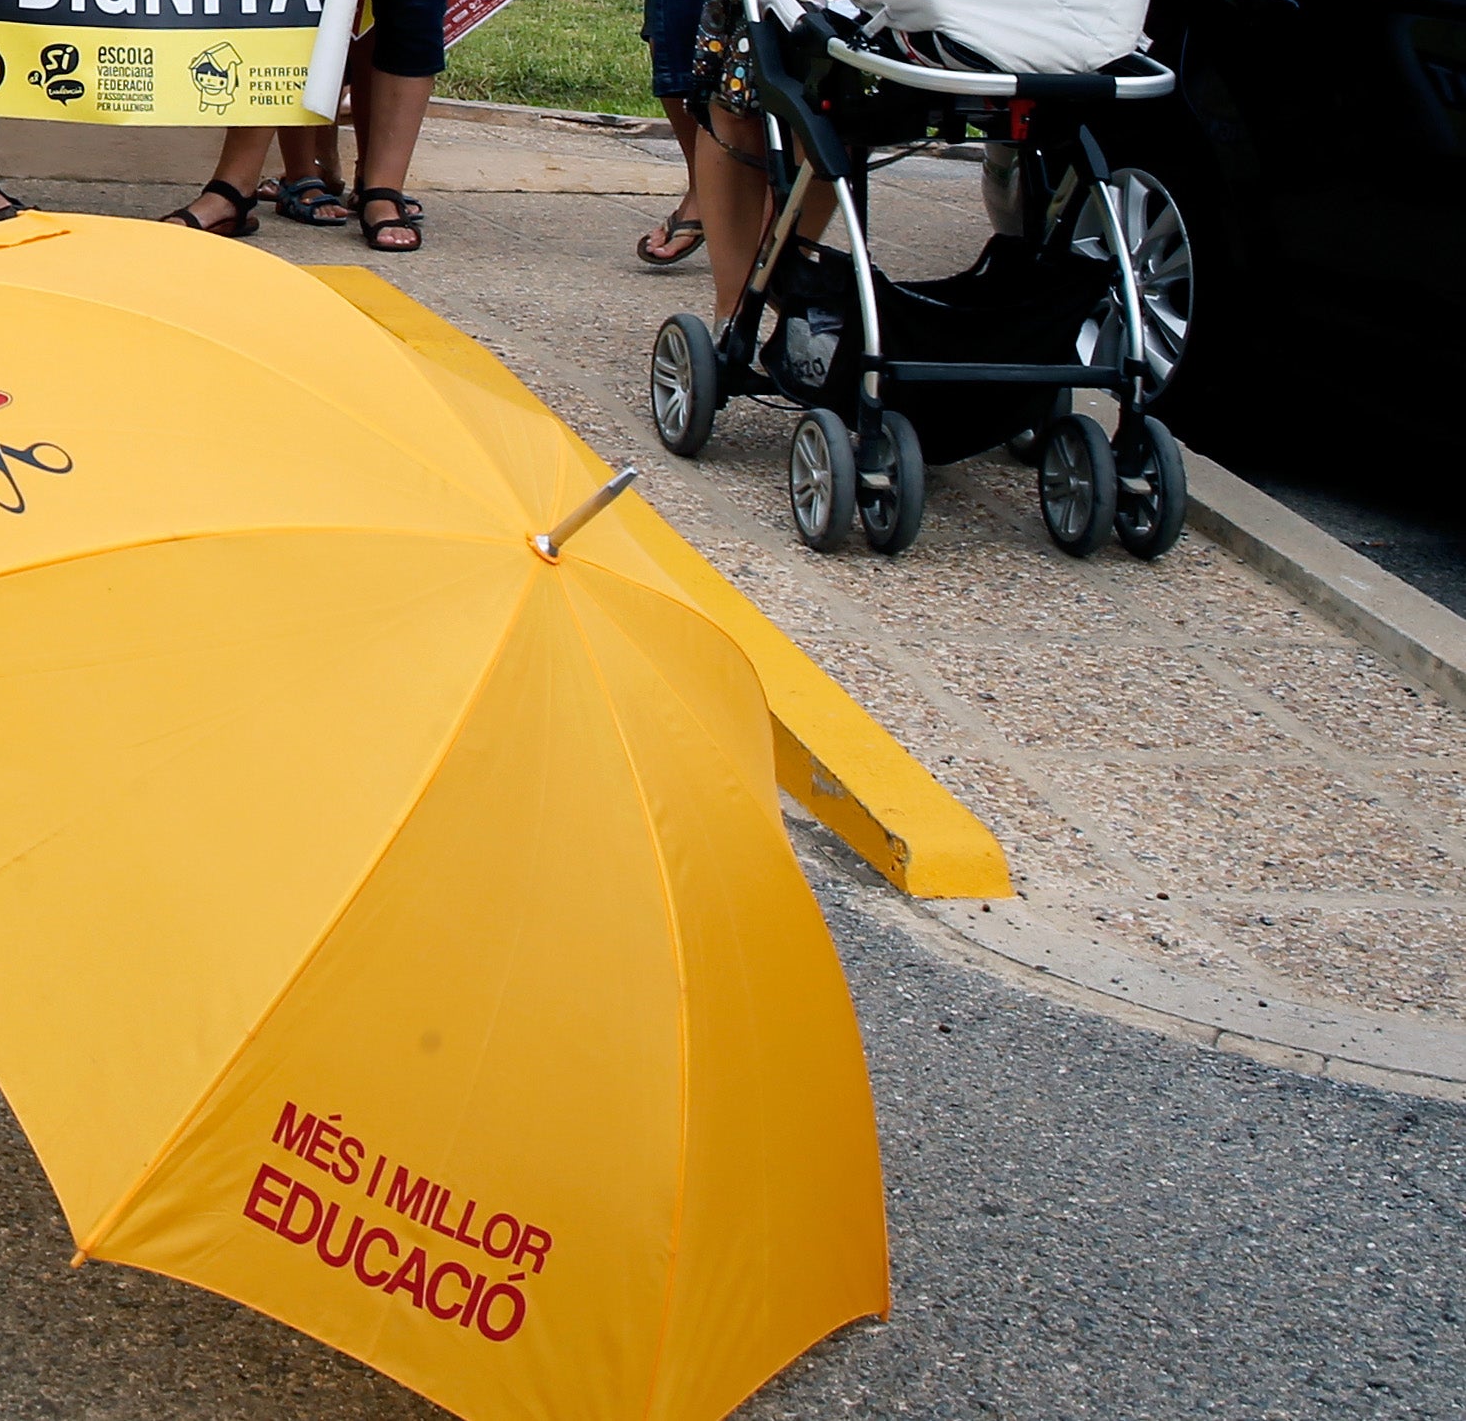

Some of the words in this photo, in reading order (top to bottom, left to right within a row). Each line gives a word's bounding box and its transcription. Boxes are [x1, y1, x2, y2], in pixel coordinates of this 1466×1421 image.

[98, 46, 154, 65] escola
[97, 65, 154, 78] valenciana
[97, 78, 154, 92] FEDERACIÓ
[249, 81, 272, 91] PER
[249, 91, 294, 105] PÚBLIC
[97, 102, 112, 111] PER
[113, 103, 121, 111] LA
[123, 103, 154, 112] LLENGUA
[271, 1100, 365, 1185] MÉS
[365, 1154, 387, 1198] I
[384, 1164, 553, 1275] MILLOR
[243, 1162, 527, 1342] EDUCACIÓ
